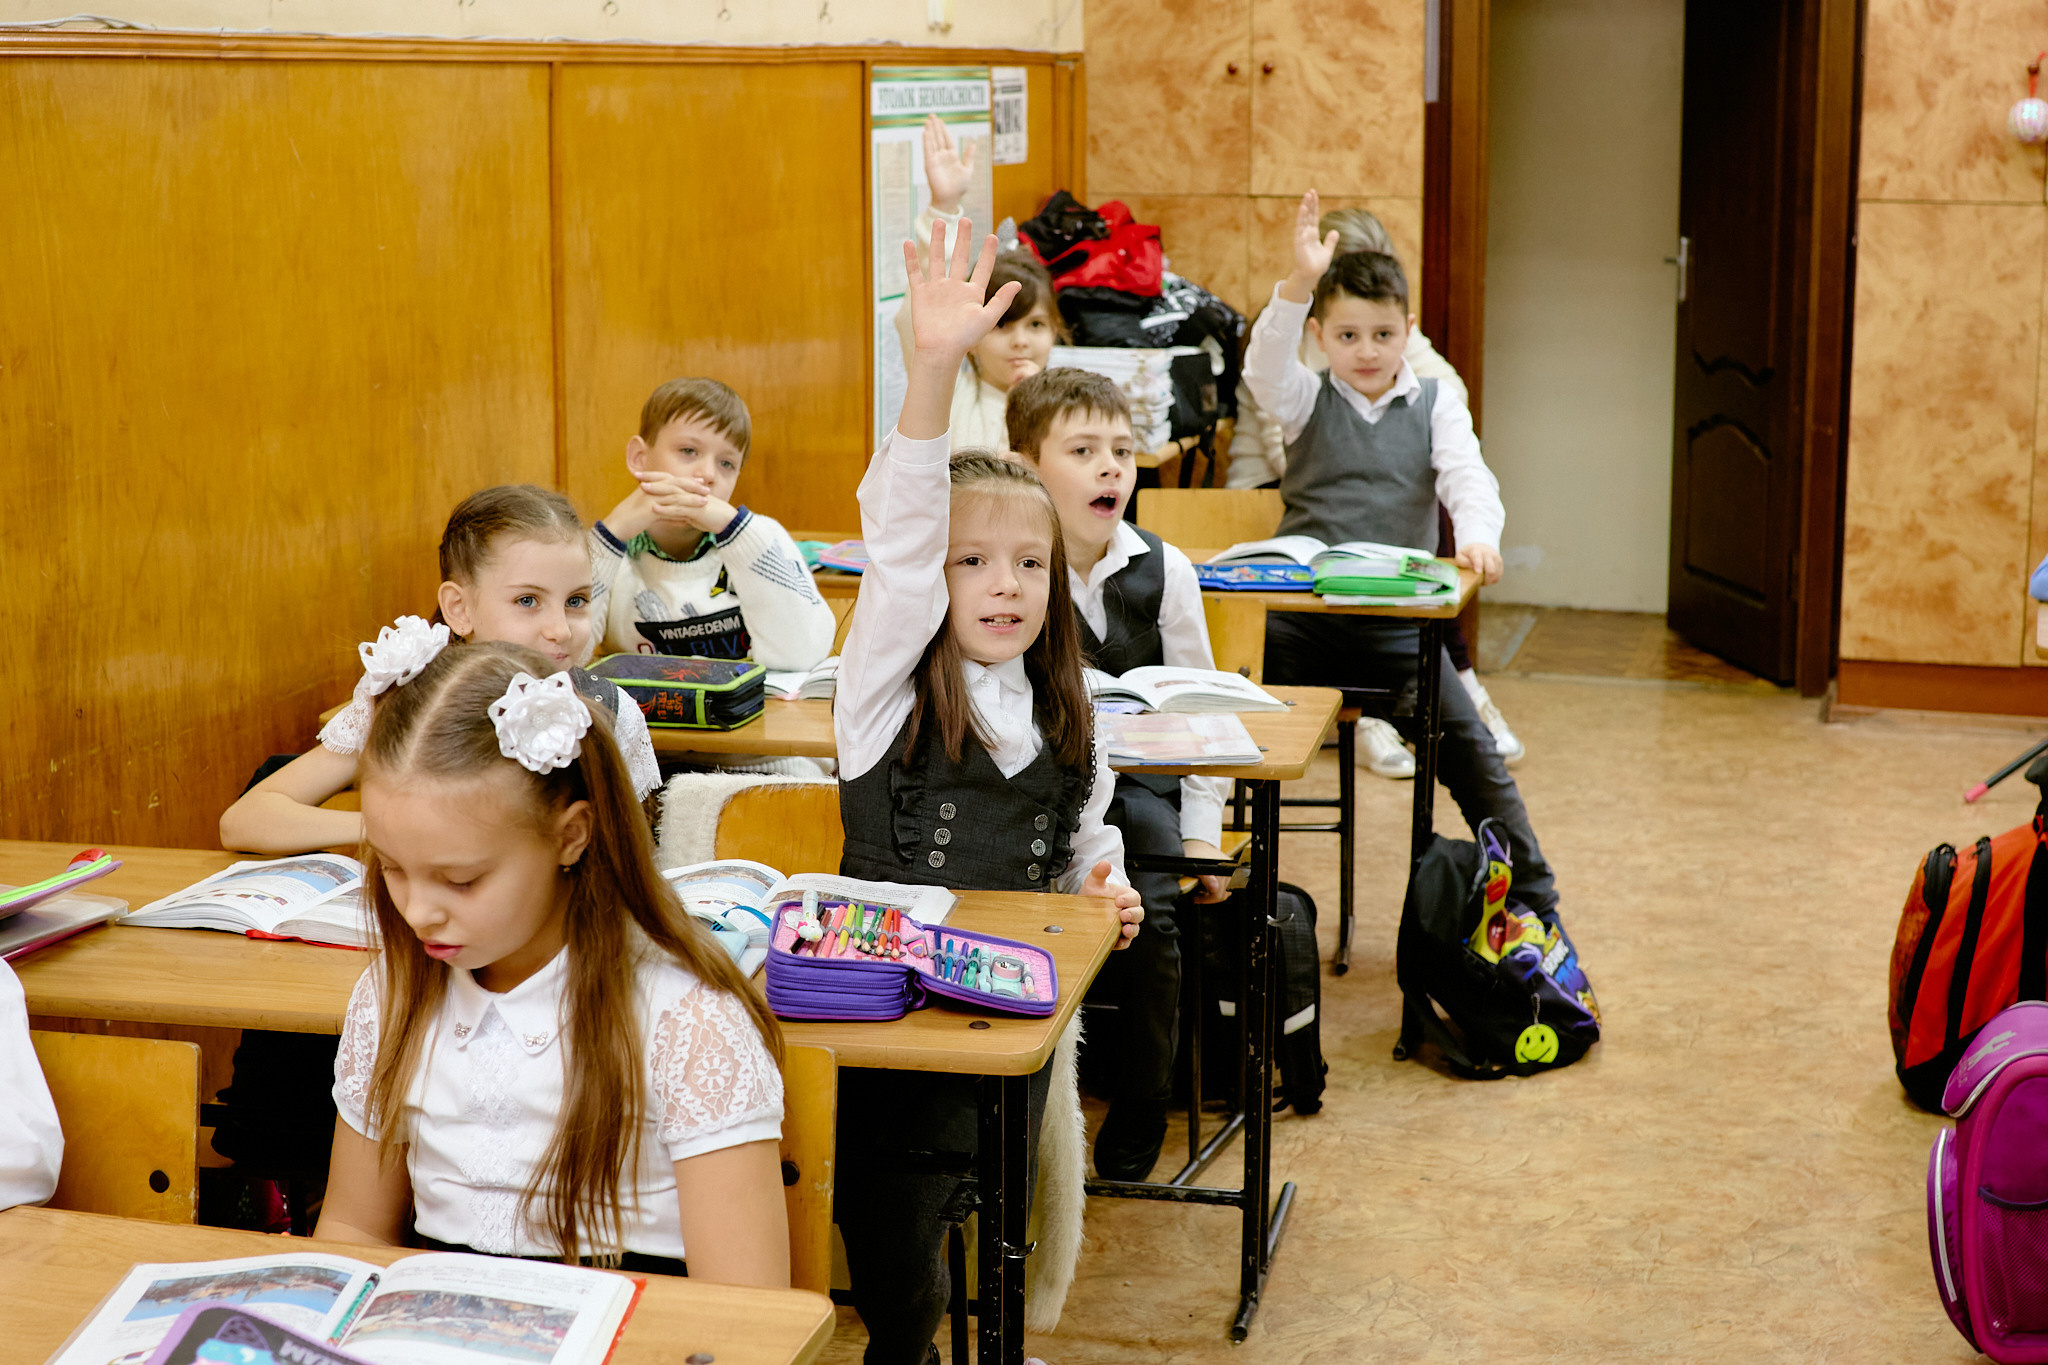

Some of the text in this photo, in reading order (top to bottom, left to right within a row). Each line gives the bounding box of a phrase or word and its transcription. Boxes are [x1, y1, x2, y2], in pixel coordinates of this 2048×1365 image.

[659, 615, 740, 640] VINTAGE DENIM
[667, 699, 673, 711] BE
[673, 692, 684, 717] JUST
